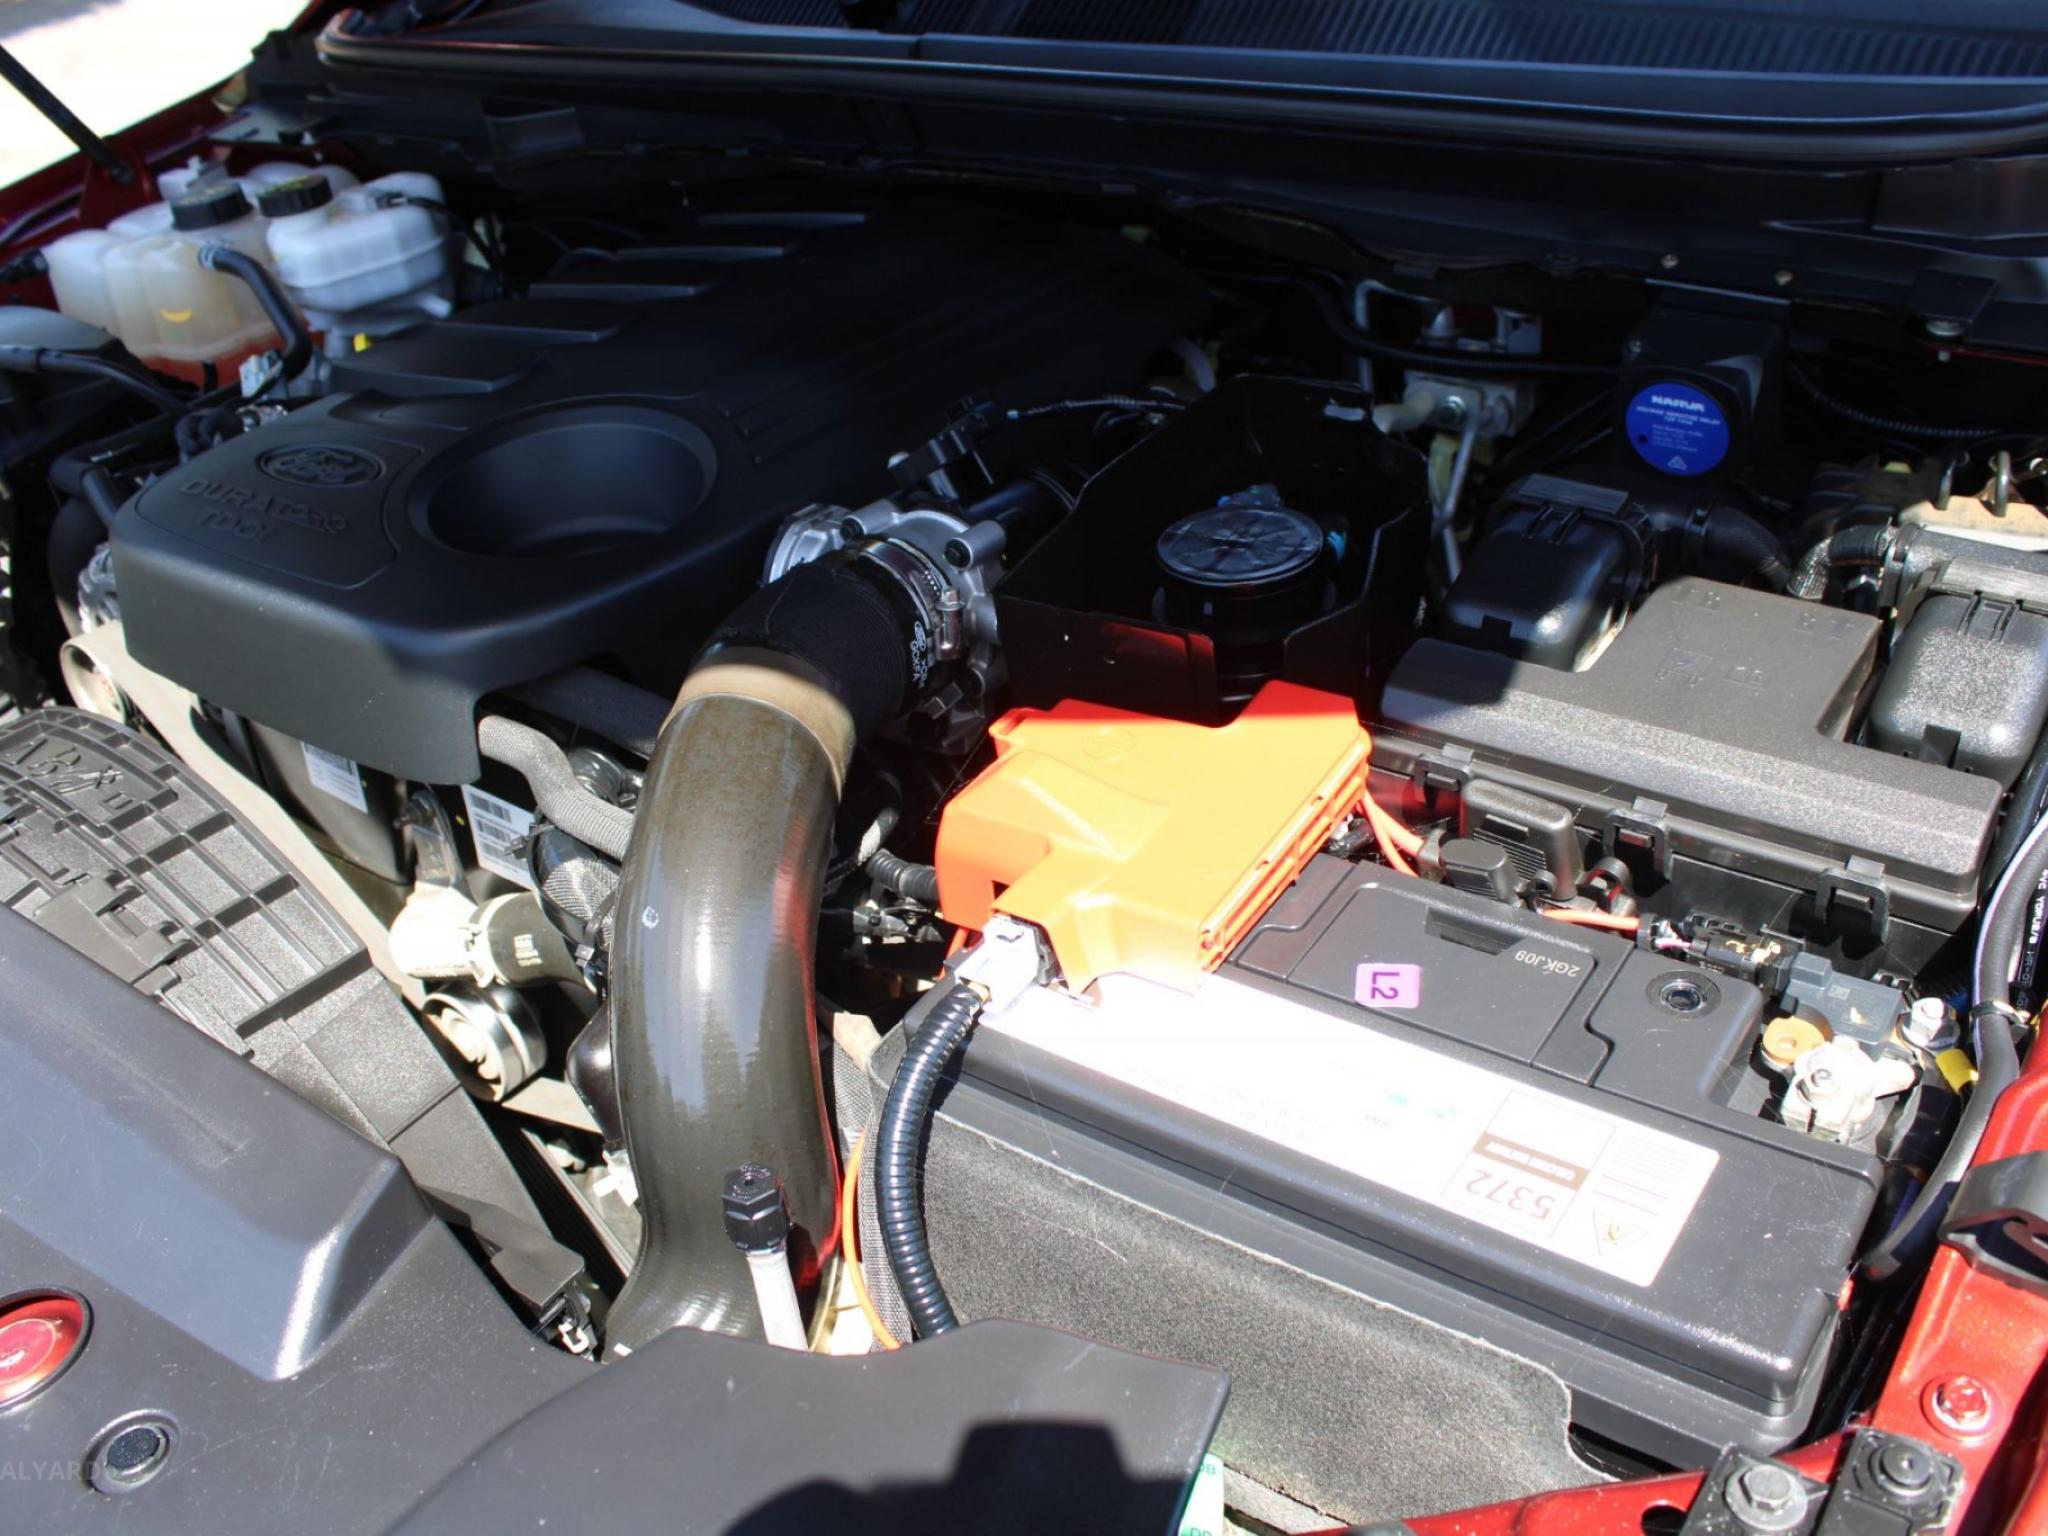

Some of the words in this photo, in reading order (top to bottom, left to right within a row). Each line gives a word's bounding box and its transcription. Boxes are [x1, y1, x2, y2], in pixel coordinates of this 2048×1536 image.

[1651, 395, 1705, 412] NARVA
[1514, 950, 1581, 977] 2GKJ09
[1371, 971, 1400, 1000] L2
[1465, 1168, 1556, 1221] 5372
